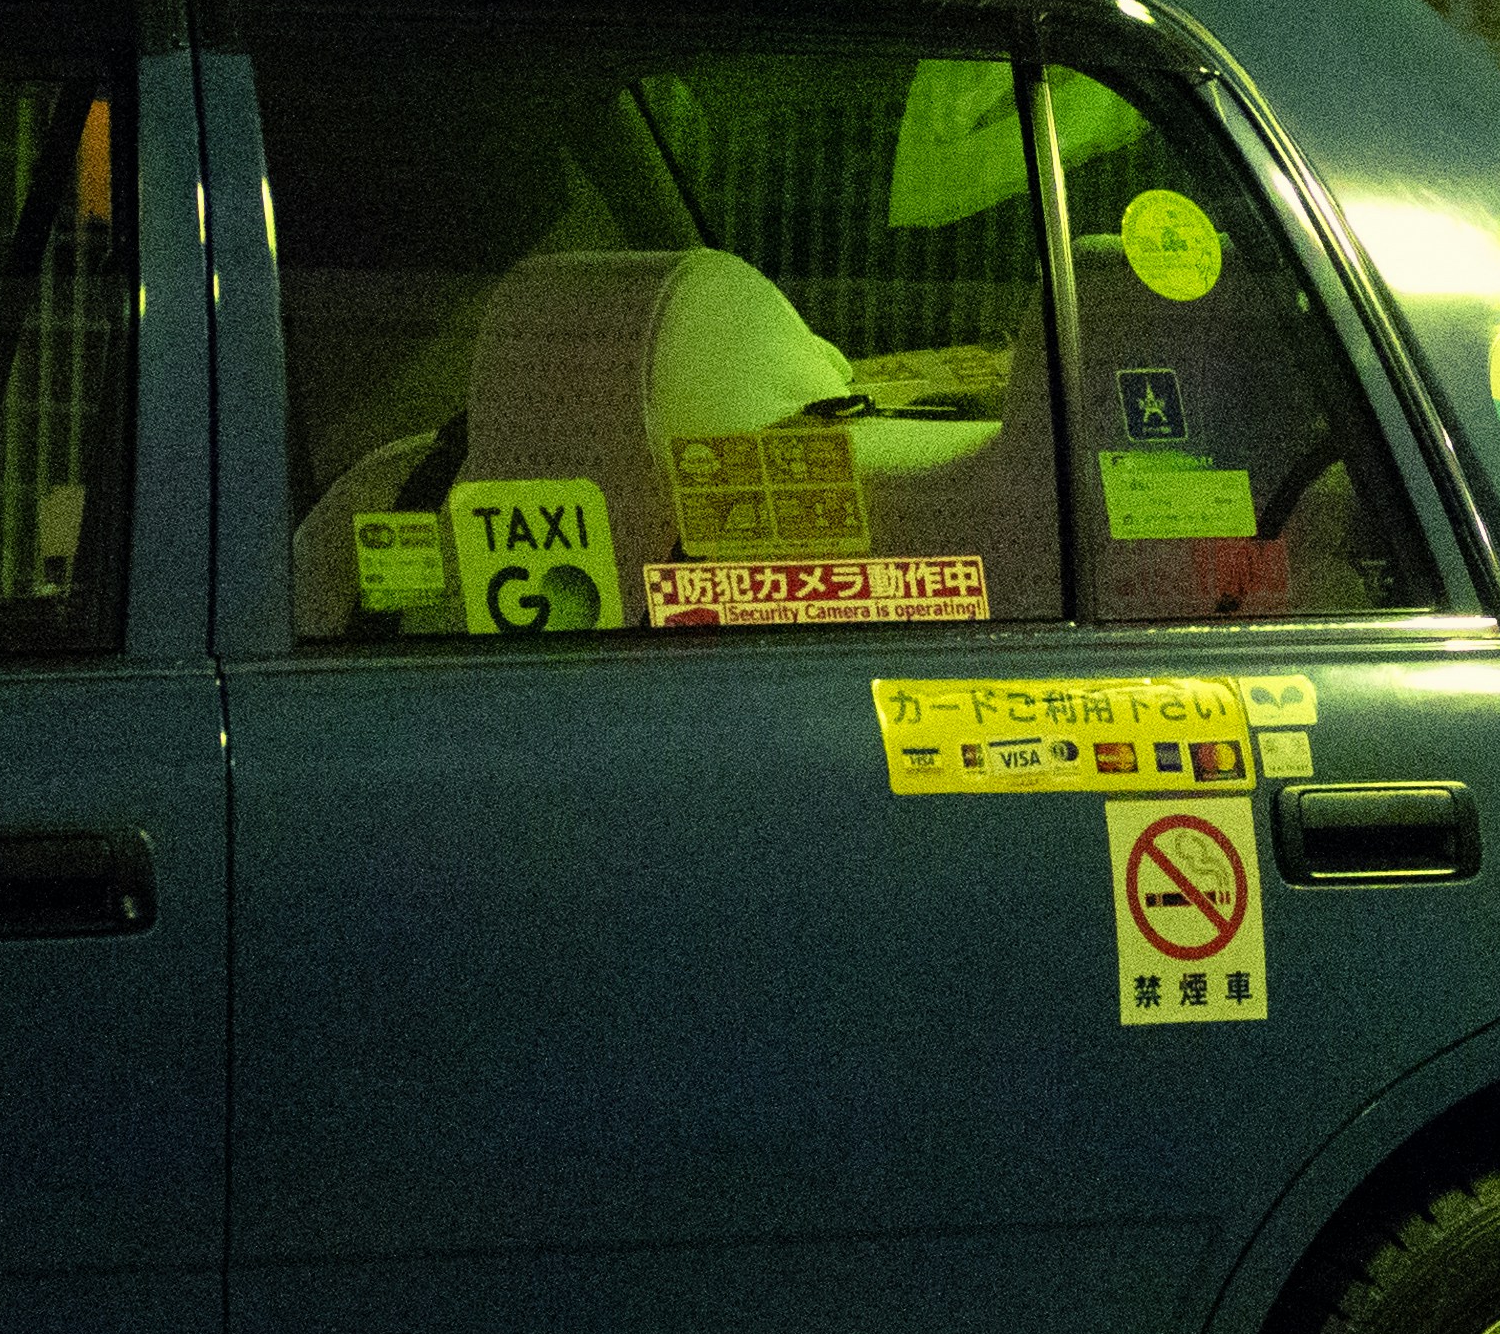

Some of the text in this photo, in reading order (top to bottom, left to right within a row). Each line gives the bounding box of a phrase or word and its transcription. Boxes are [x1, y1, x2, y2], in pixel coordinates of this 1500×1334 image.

[474, 505, 586, 551] TAXI
[677, 563, 980, 604] 防犯カメラ動作中
[729, 599, 983, 624] Security Camera is operating!
[889, 690, 1228, 725] カードご利用下さい
[1000, 750, 1041, 769] VISA
[1133, 972, 1253, 1008] 禁煙車
